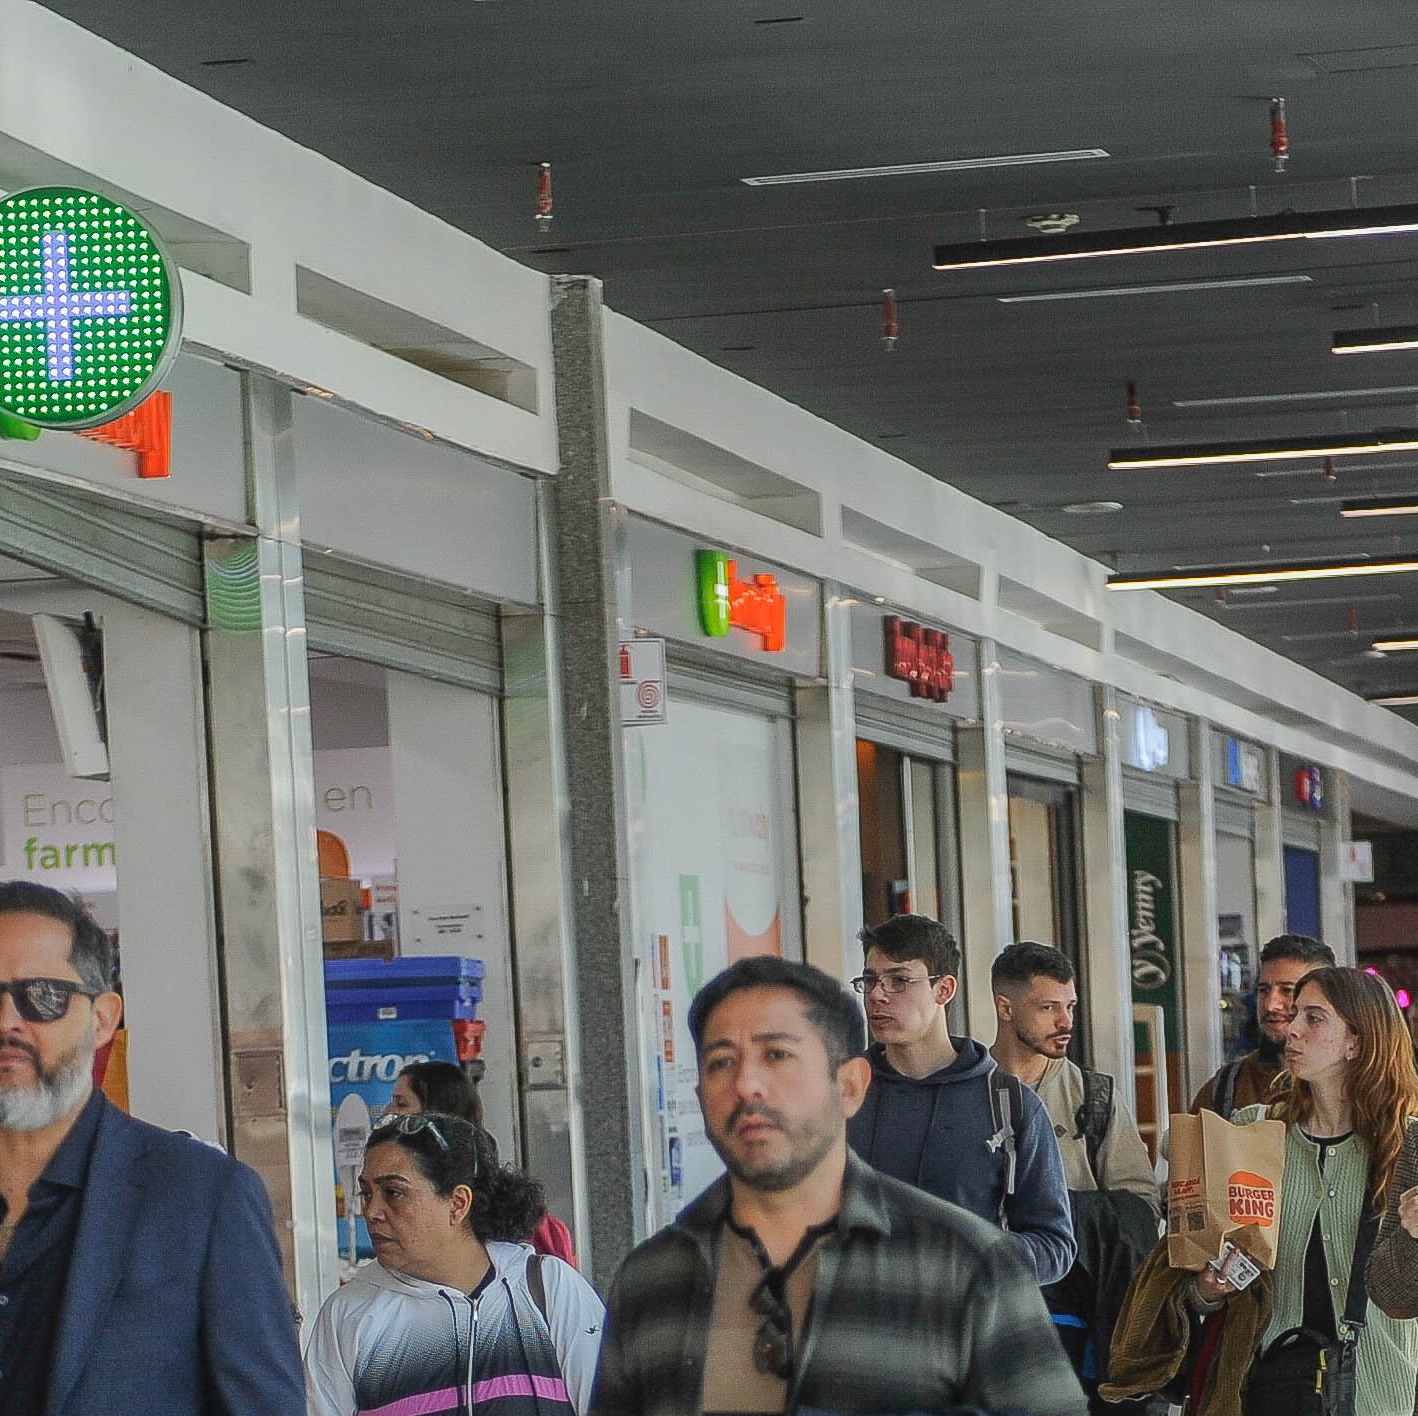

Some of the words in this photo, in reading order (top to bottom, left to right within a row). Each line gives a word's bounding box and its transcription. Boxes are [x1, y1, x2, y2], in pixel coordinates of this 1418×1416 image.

[324, 785, 373, 812] en
[1229, 1186, 1275, 1201] BURGER
[1229, 1199, 1274, 1218] KING
